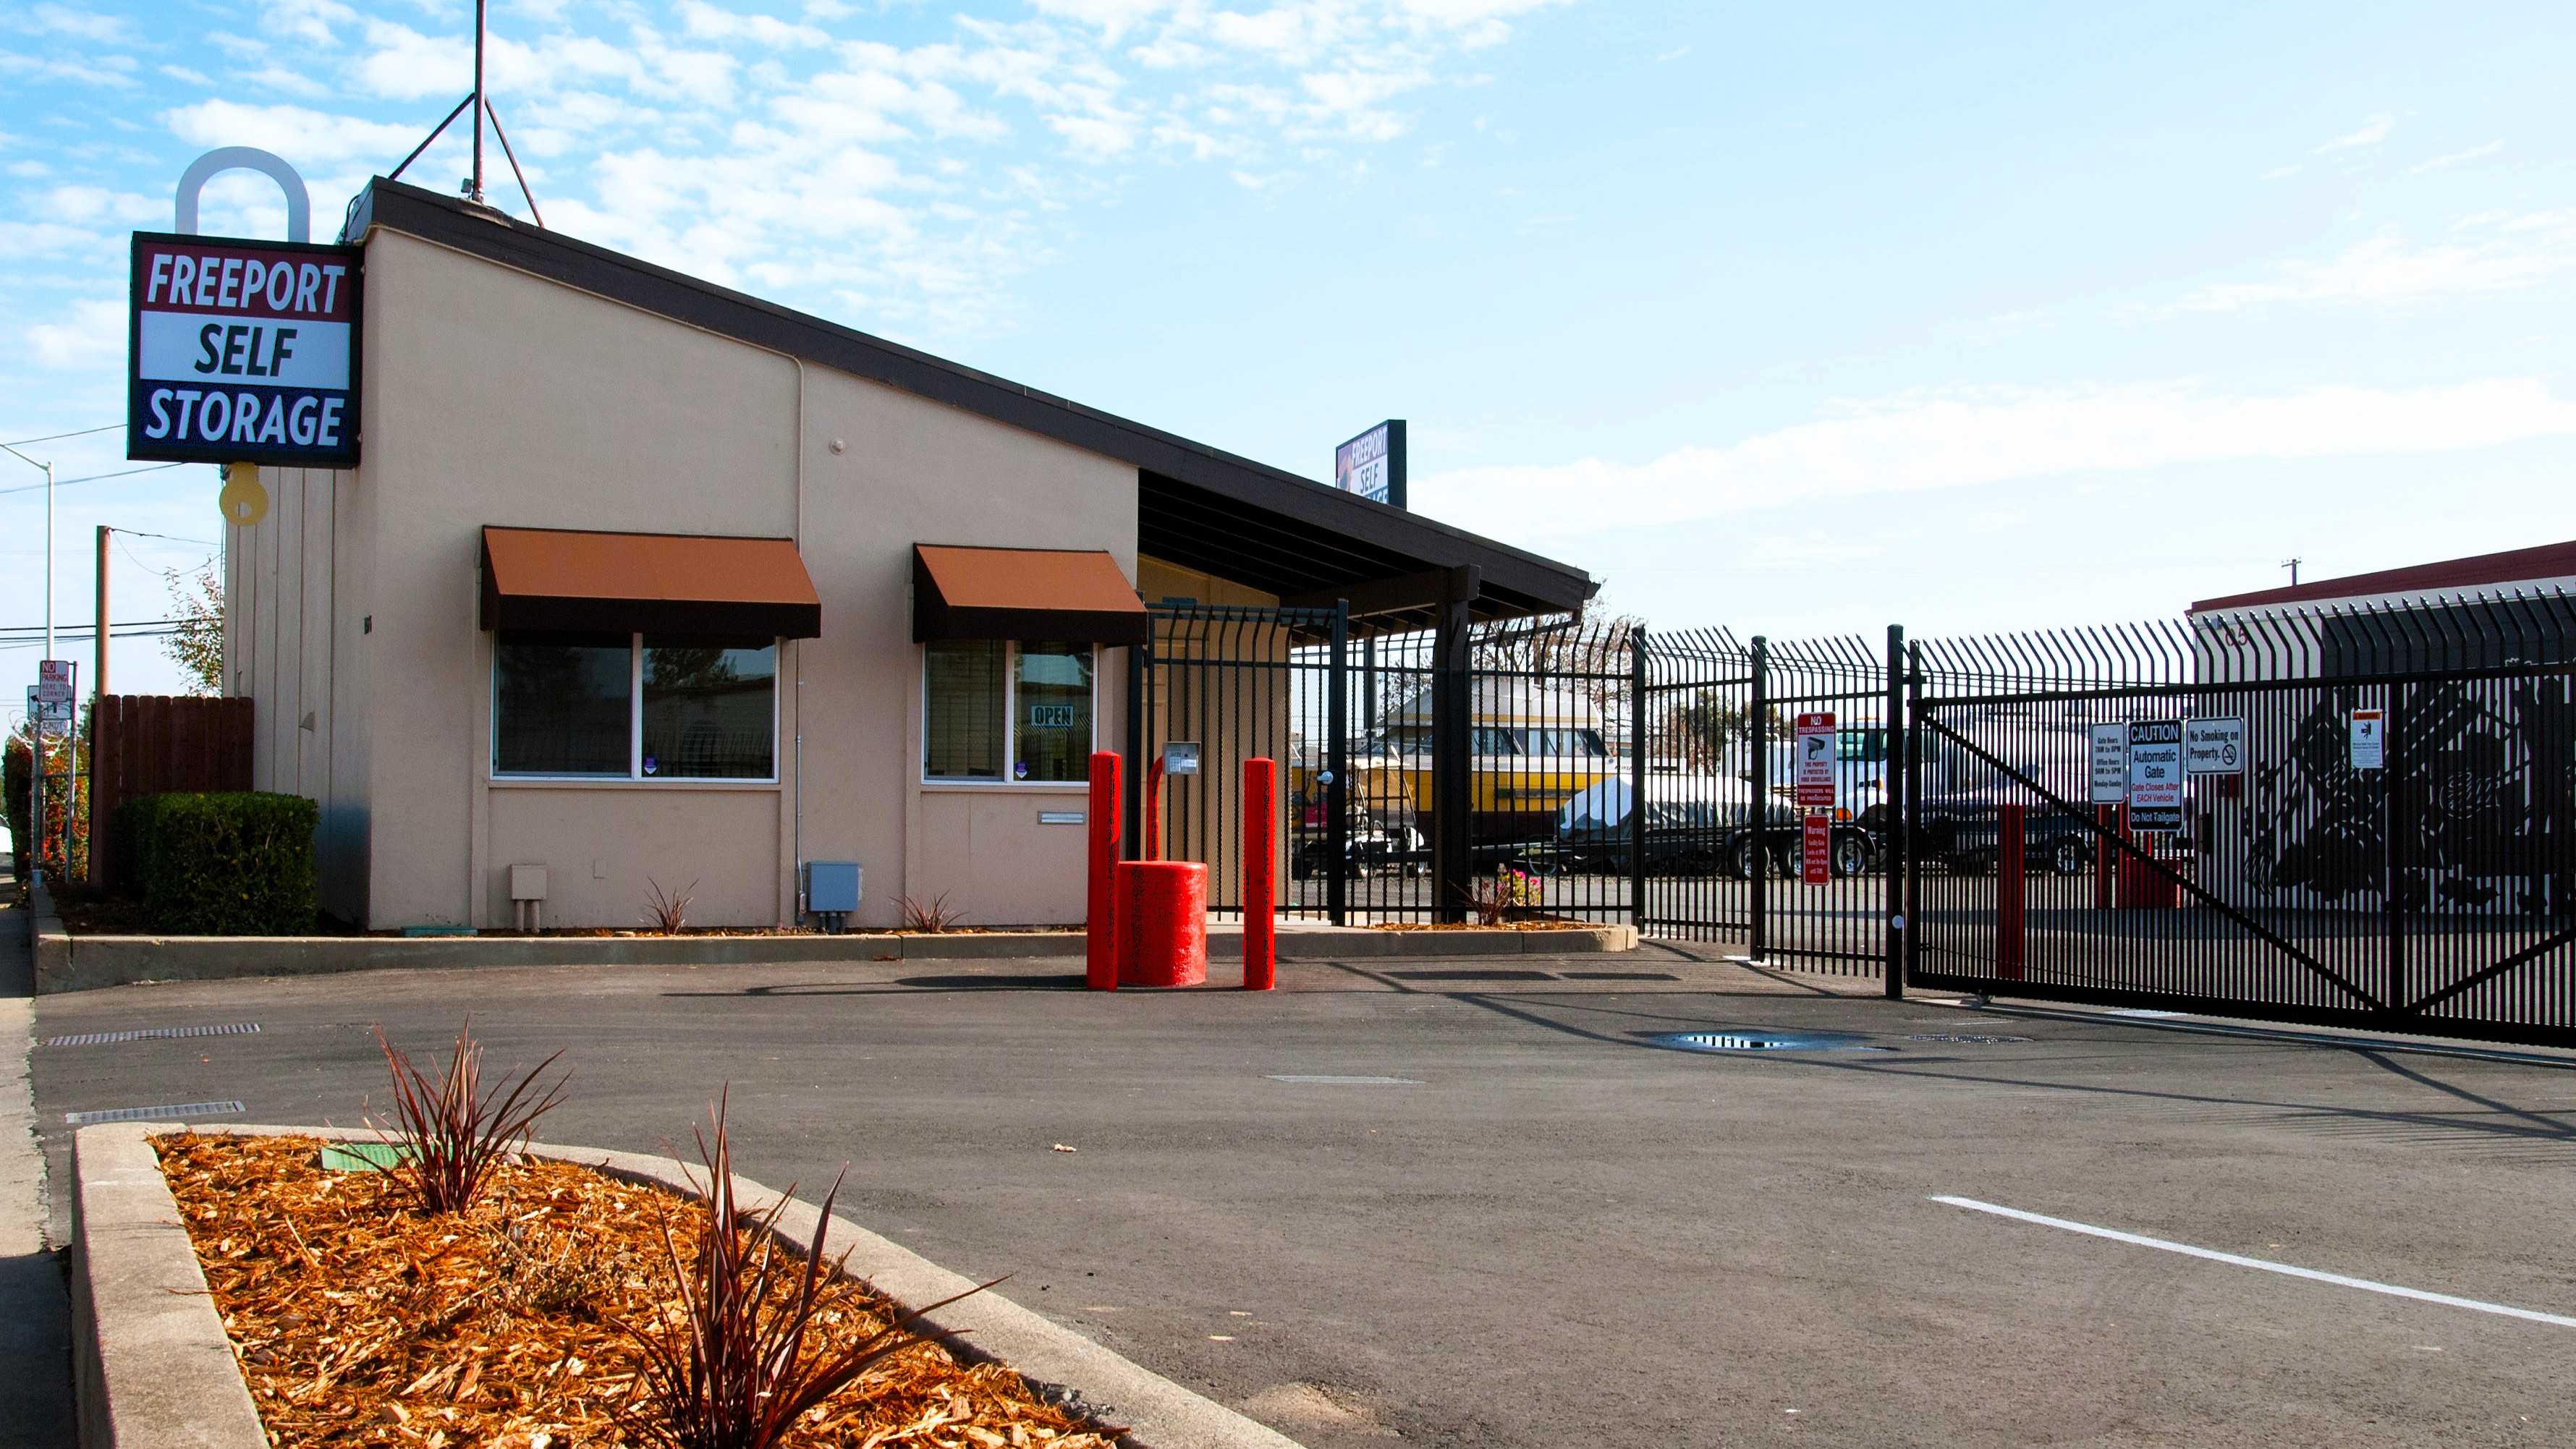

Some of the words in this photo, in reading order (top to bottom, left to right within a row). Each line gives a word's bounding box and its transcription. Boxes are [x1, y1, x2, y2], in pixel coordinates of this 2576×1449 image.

[147, 253, 346, 313] FREEPORT
[194, 323, 298, 377] SELF
[145, 388, 345, 446] STORAGE
[1352, 427, 1388, 466] FREEPORT
[1360, 462, 1378, 493] SELF
[42, 662, 55, 672] NO
[1034, 707, 1071, 725] OPEN
[1810, 716, 1822, 726] NO
[2131, 724, 2178, 742] CAUTION
[2190, 730, 2198, 742] No
[2201, 729, 2228, 744] Smoking
[2230, 731, 2238, 741] on
[2134, 749, 2176, 763] Automatic
[2190, 747, 2220, 762] Property.
[2145, 766, 2165, 778] Gate
[2145, 783, 2164, 791] Closes
[2165, 782, 2179, 791] After
[2136, 794, 2152, 803] EACH
[2153, 794, 2174, 802] Vehicle
[2131, 813, 2140, 822] Do
[2141, 812, 2152, 822] Not
[2153, 812, 2180, 824] Tailgate
[1807, 826, 1826, 836] Warning
